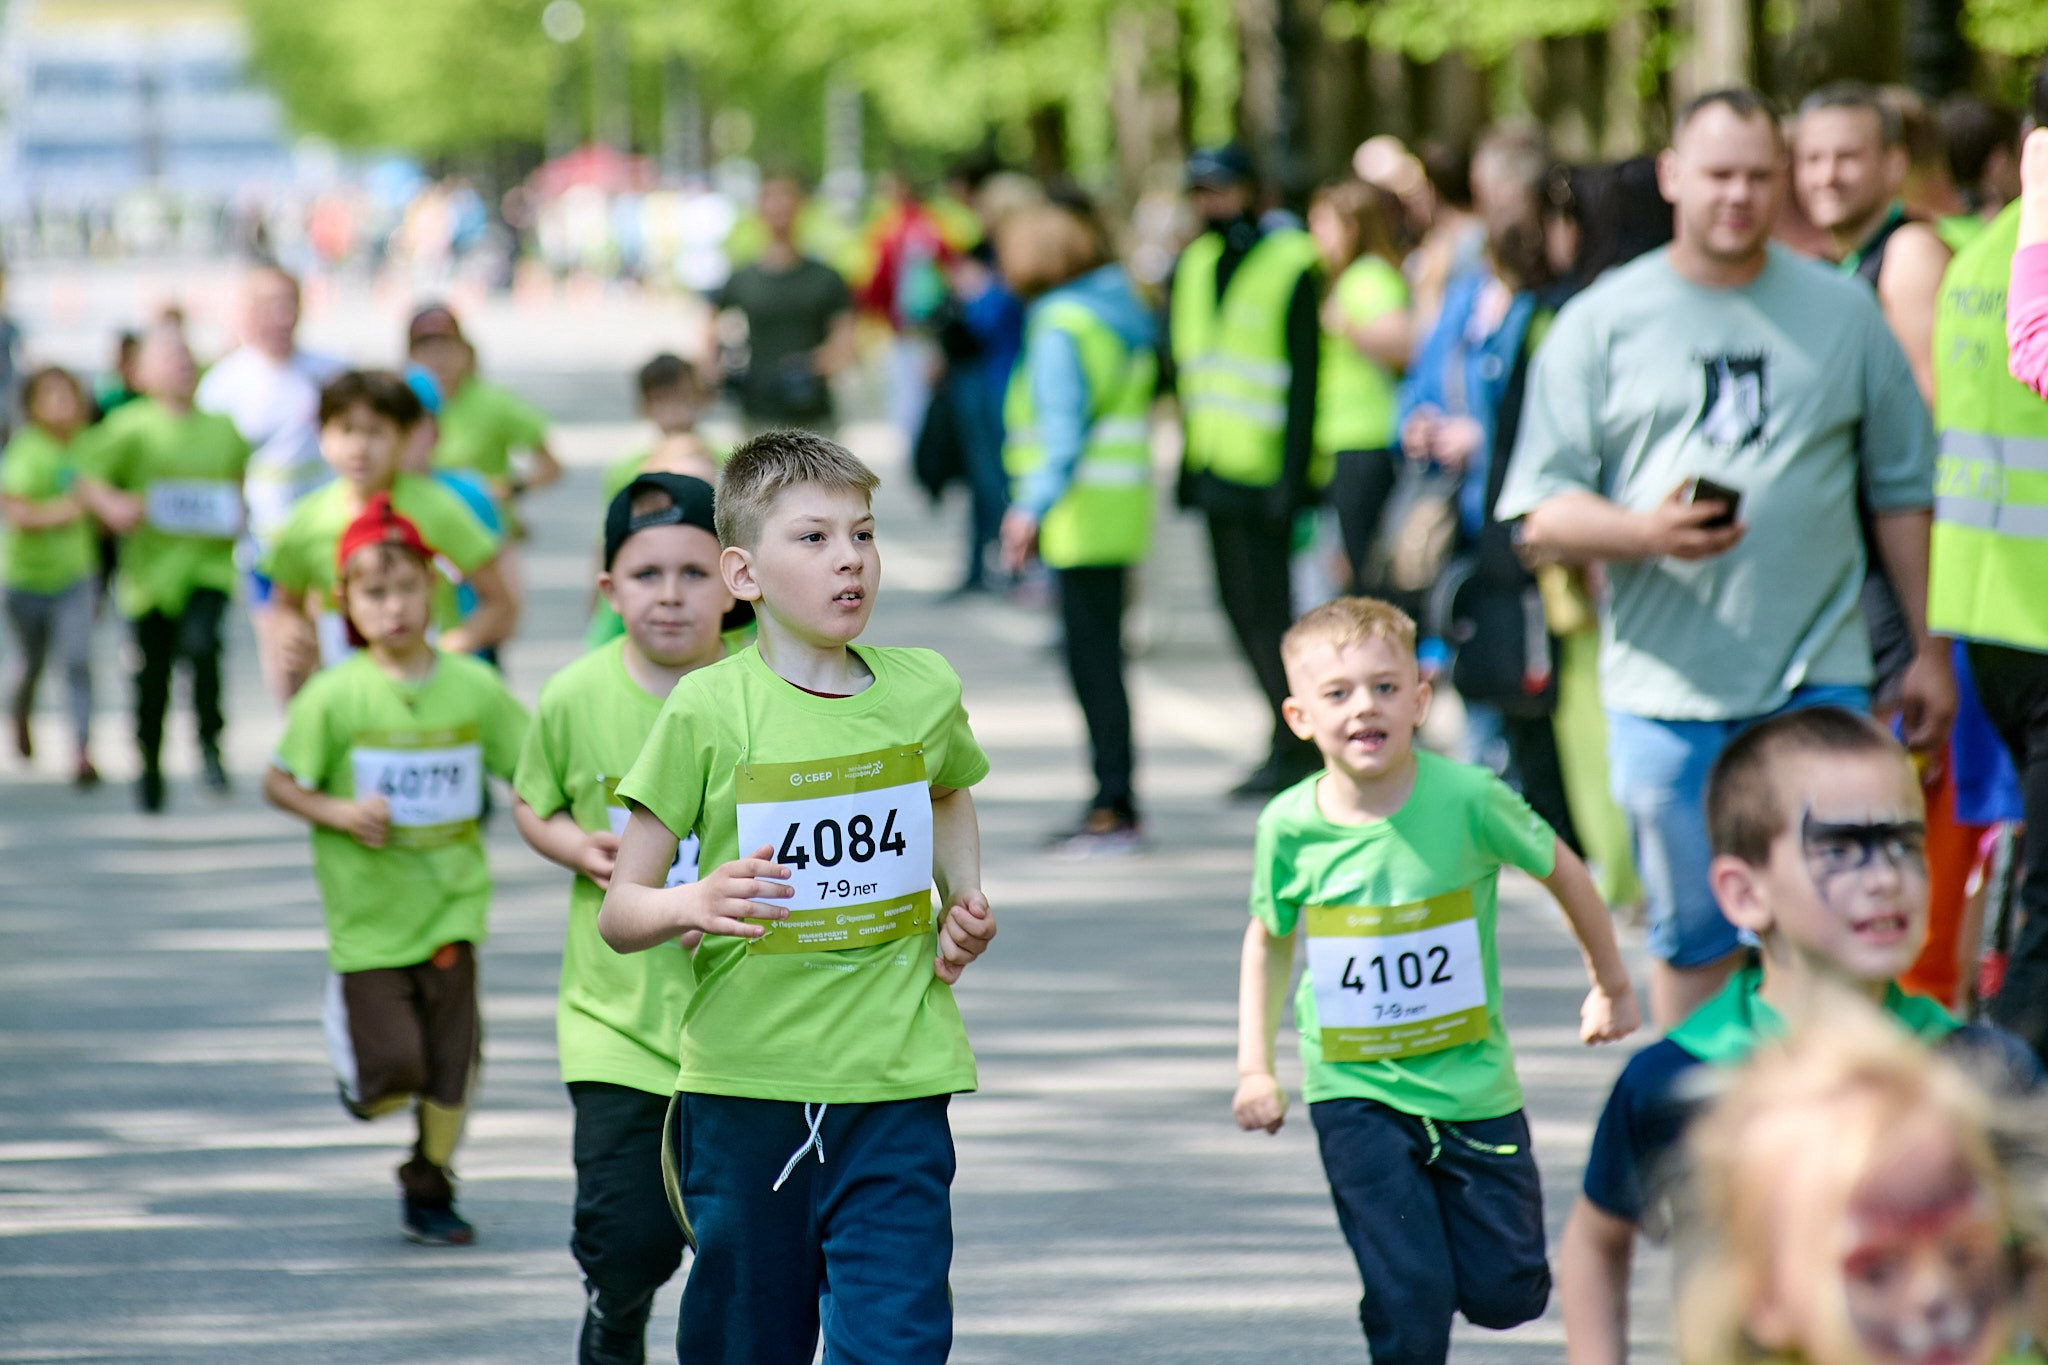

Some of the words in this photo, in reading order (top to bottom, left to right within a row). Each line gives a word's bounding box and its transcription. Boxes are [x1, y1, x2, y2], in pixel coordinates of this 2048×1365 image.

[804, 771, 833, 784] СБЕР
[777, 808, 906, 870] 4084
[817, 880, 851, 900] 7-9
[853, 883, 878, 896] лет
[778, 920, 825, 930] Перекрёсток
[1340, 945, 1453, 995] 4102
